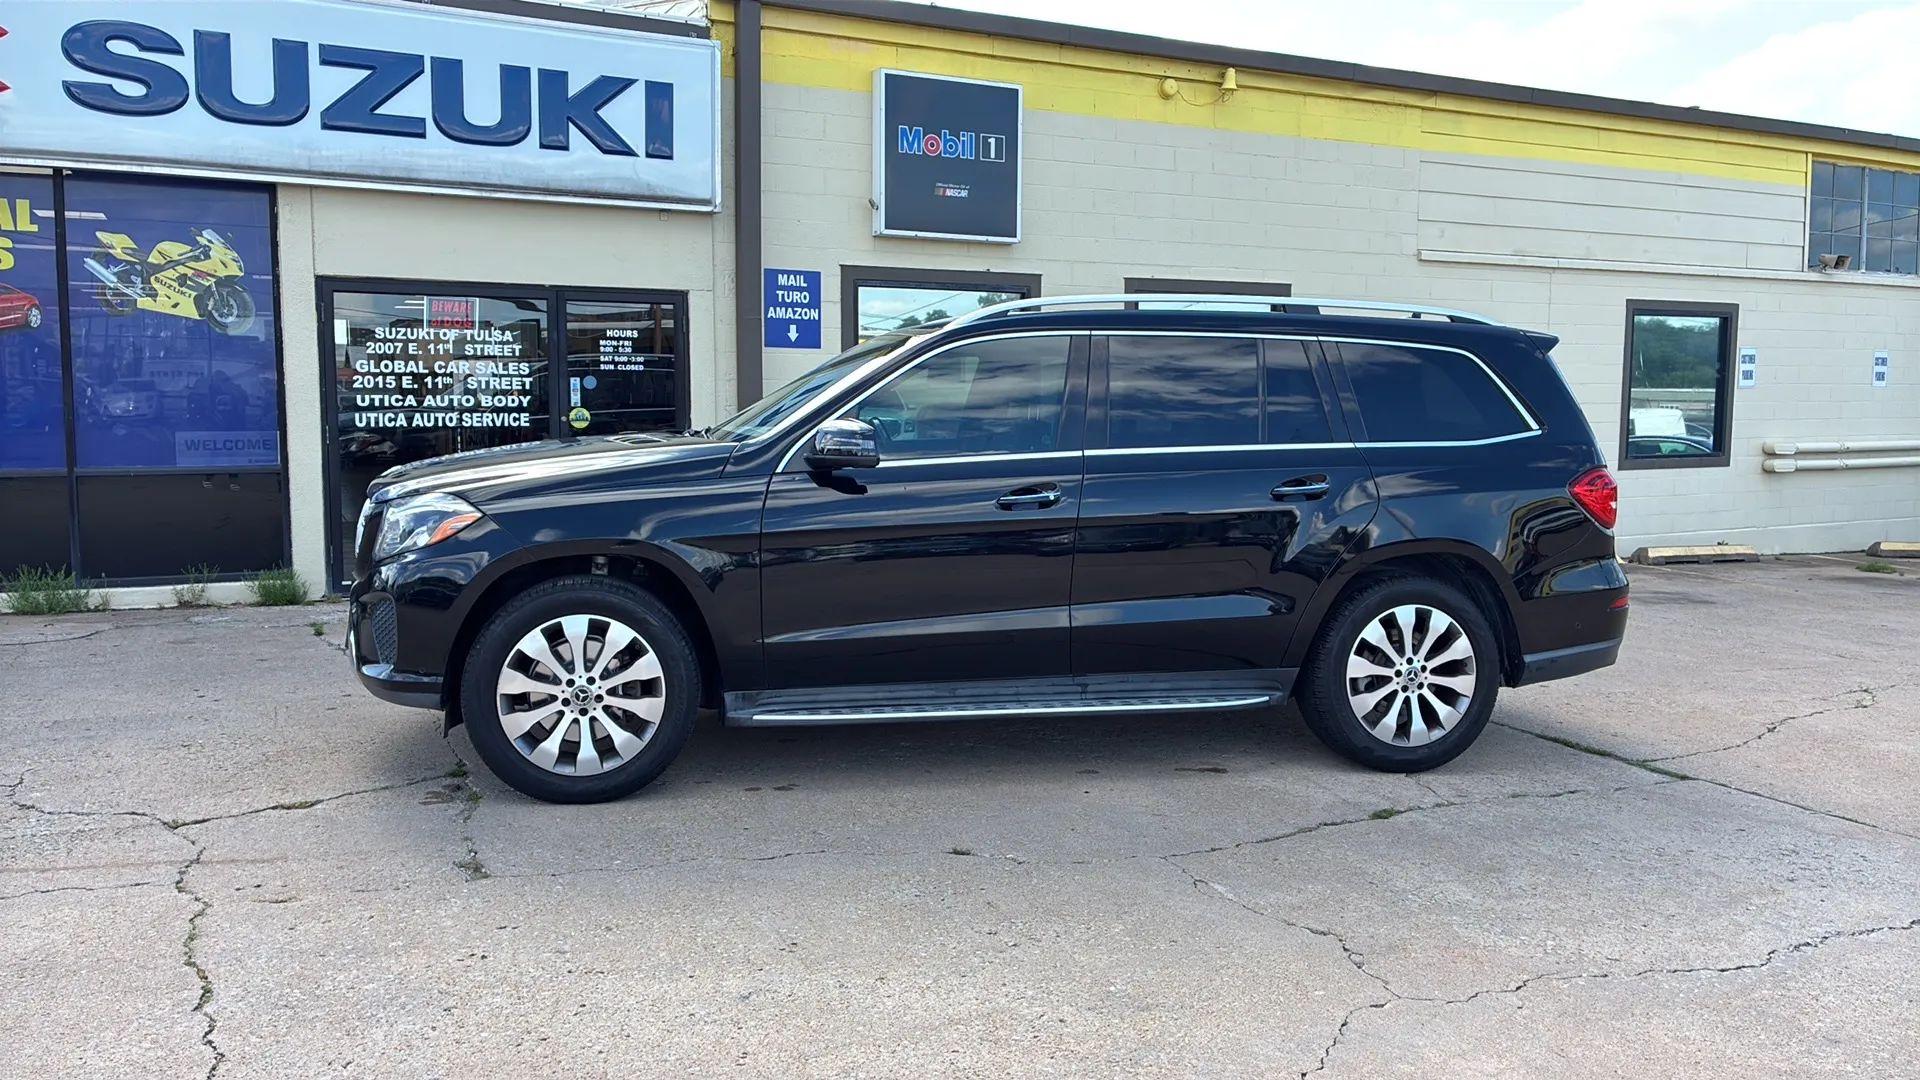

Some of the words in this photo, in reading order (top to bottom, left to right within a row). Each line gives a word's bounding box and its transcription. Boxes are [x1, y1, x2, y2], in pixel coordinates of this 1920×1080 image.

[61, 20, 675, 160] SUZUKI
[898, 125, 975, 160] Mobil
[987, 137, 996, 159] 1
[153, 276, 192, 299] SUZUKI
[777, 273, 808, 287] MAIL
[776, 290, 810, 304] TURO
[431, 300, 473, 313] BEWARE
[767, 306, 819, 321] AMAZON
[374, 327, 434, 340] SUZUKI
[440, 329, 459, 340] OF
[464, 329, 513, 342] TULSA
[606, 329, 639, 338] HOURS
[365, 341, 404, 355] 2007
[408, 342, 423, 355] E.
[464, 343, 522, 357] STREET
[599, 339, 633, 347] MON-FRI
[355, 359, 430, 374] GLOBAL
[433, 360, 471, 374] CAR
[475, 361, 530, 375] SALES
[352, 375, 397, 389] 2015
[401, 375, 419, 389] E.
[466, 376, 533, 390] STREET
[356, 394, 418, 407] UTICA
[422, 394, 475, 408] AUTO
[481, 395, 532, 408] BODY
[354, 412, 408, 428] UTICA
[411, 412, 458, 428] AUTO
[461, 412, 530, 428] SERVICE
[184, 438, 273, 452] WELCOME
